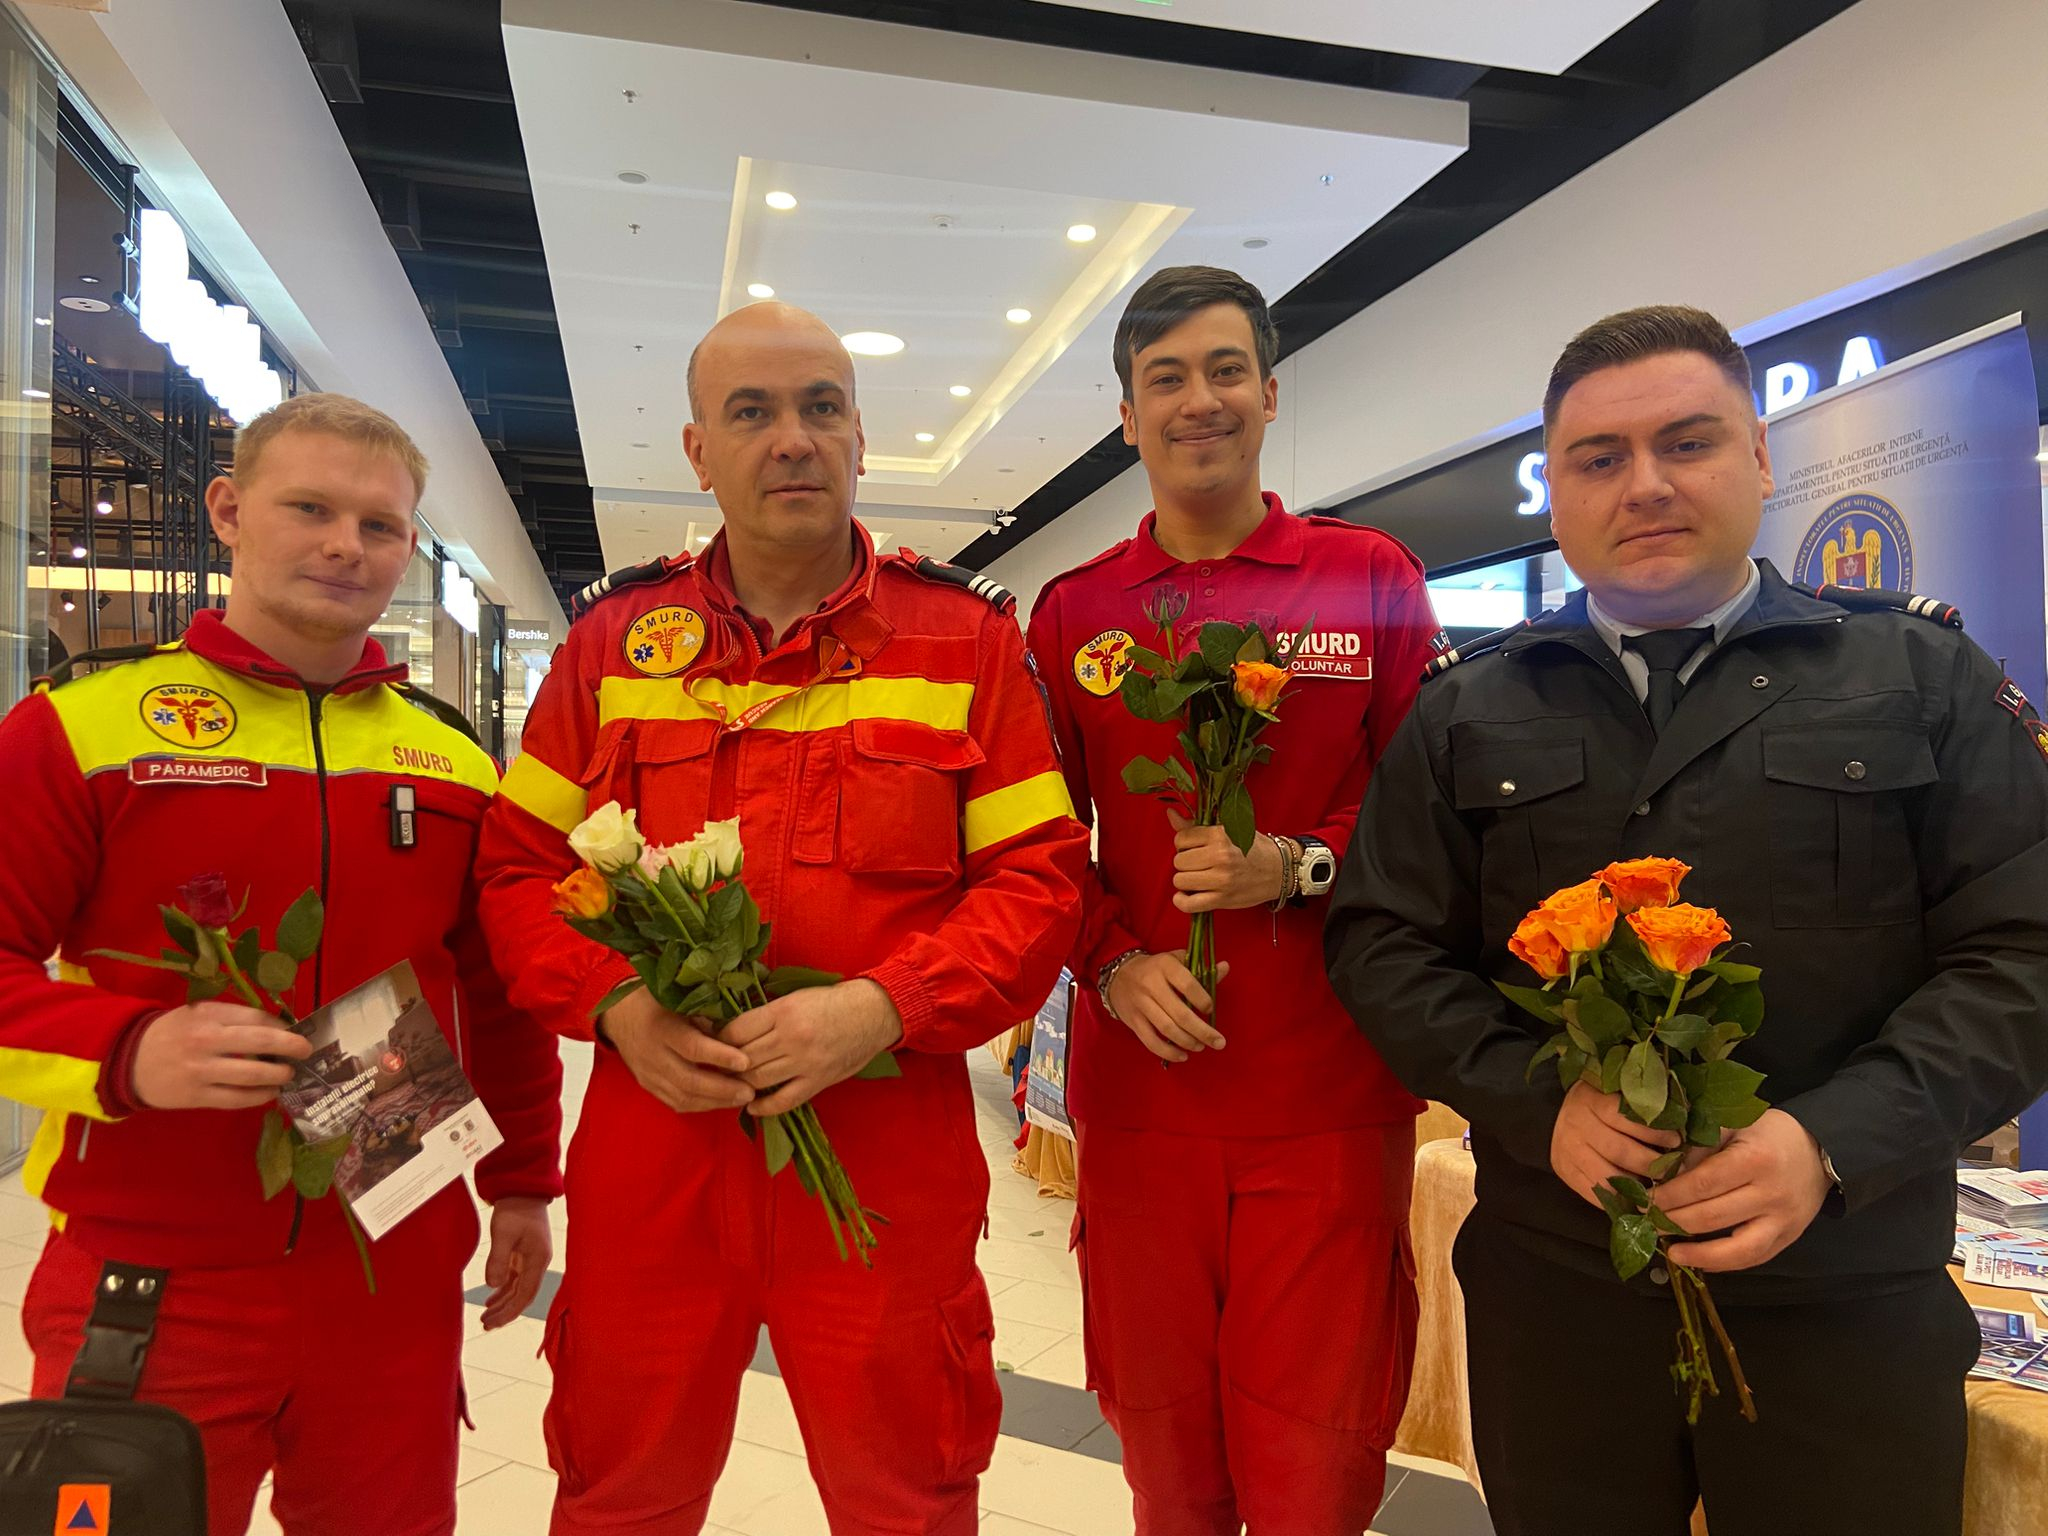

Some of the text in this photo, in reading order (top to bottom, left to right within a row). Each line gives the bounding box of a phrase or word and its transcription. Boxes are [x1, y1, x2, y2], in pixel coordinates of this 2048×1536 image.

[1789, 428, 1924, 481] MINISTERUL AFACERILOR INTERNE
[1762, 492, 1811, 514] PECTORATUL
[1811, 481, 1847, 500] GENERAL
[1847, 471, 1880, 490] PENTRU
[1915, 455, 1927, 469] DE
[1773, 472, 1831, 500] EPARTAMENTUL
[1831, 463, 1862, 481] PENTRU
[1899, 447, 1910, 460] DE
[507, 628, 549, 640] Bershka
[634, 611, 694, 634] SMURD
[1087, 631, 1124, 651] SMURD
[1285, 660, 1352, 674] OLUNTAR
[159, 687, 210, 698] SMURD
[149, 764, 250, 778] PARAMEDIC
[392, 745, 453, 774] SMURD
[341, 1065, 379, 1093] electrice
